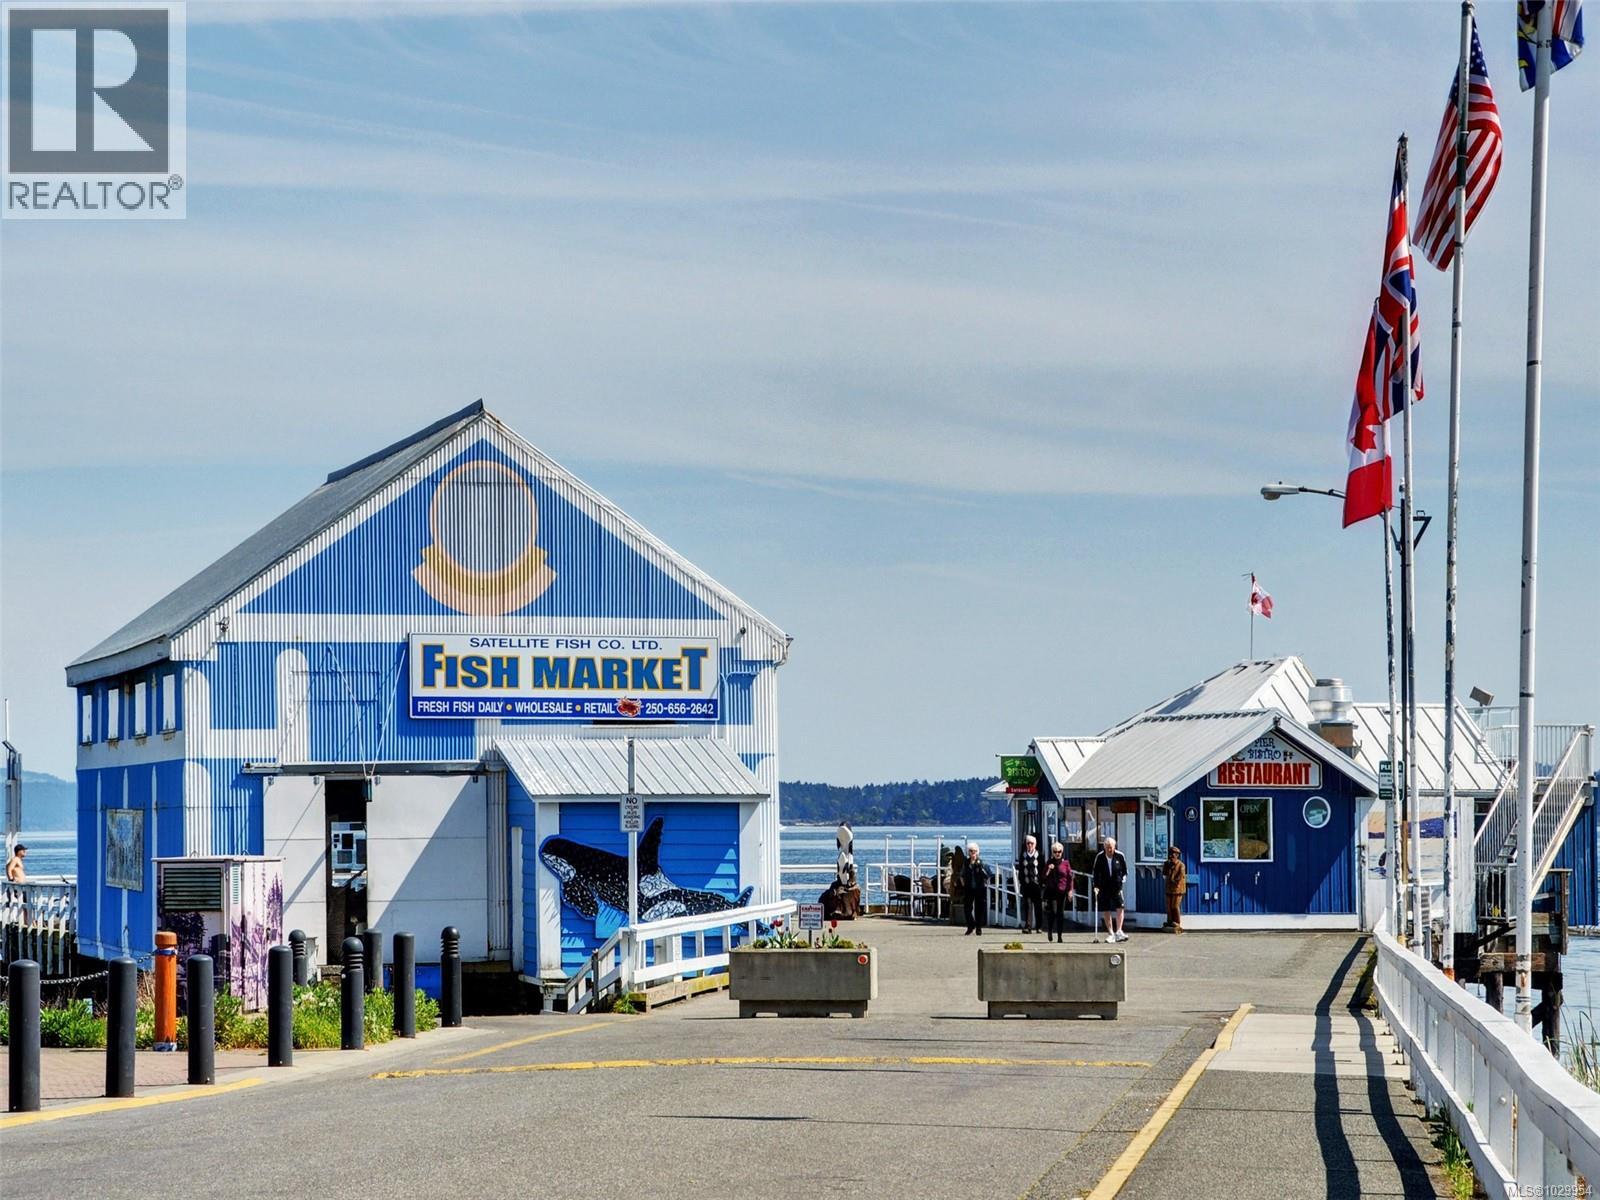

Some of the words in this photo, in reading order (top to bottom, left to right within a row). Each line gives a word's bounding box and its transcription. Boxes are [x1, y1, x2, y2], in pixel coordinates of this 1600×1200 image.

[470, 638, 549, 650] SATELLITE
[556, 639, 591, 649] FISH
[598, 640, 625, 650] CO.
[632, 640, 662, 650] LTD.
[417, 701, 450, 713] FRESH
[453, 702, 475, 713] FISH
[478, 702, 504, 713] DAILY
[515, 702, 573, 714] WHOLESALE
[584, 702, 615, 714] RETAIL
[645, 702, 714, 715] 250-656-2642
[1254, 737, 1275, 749] PIER
[1248, 748, 1282, 760] BISTRO
[1217, 762, 1312, 785] RESTAURANT
[626, 797, 638, 805] NO
